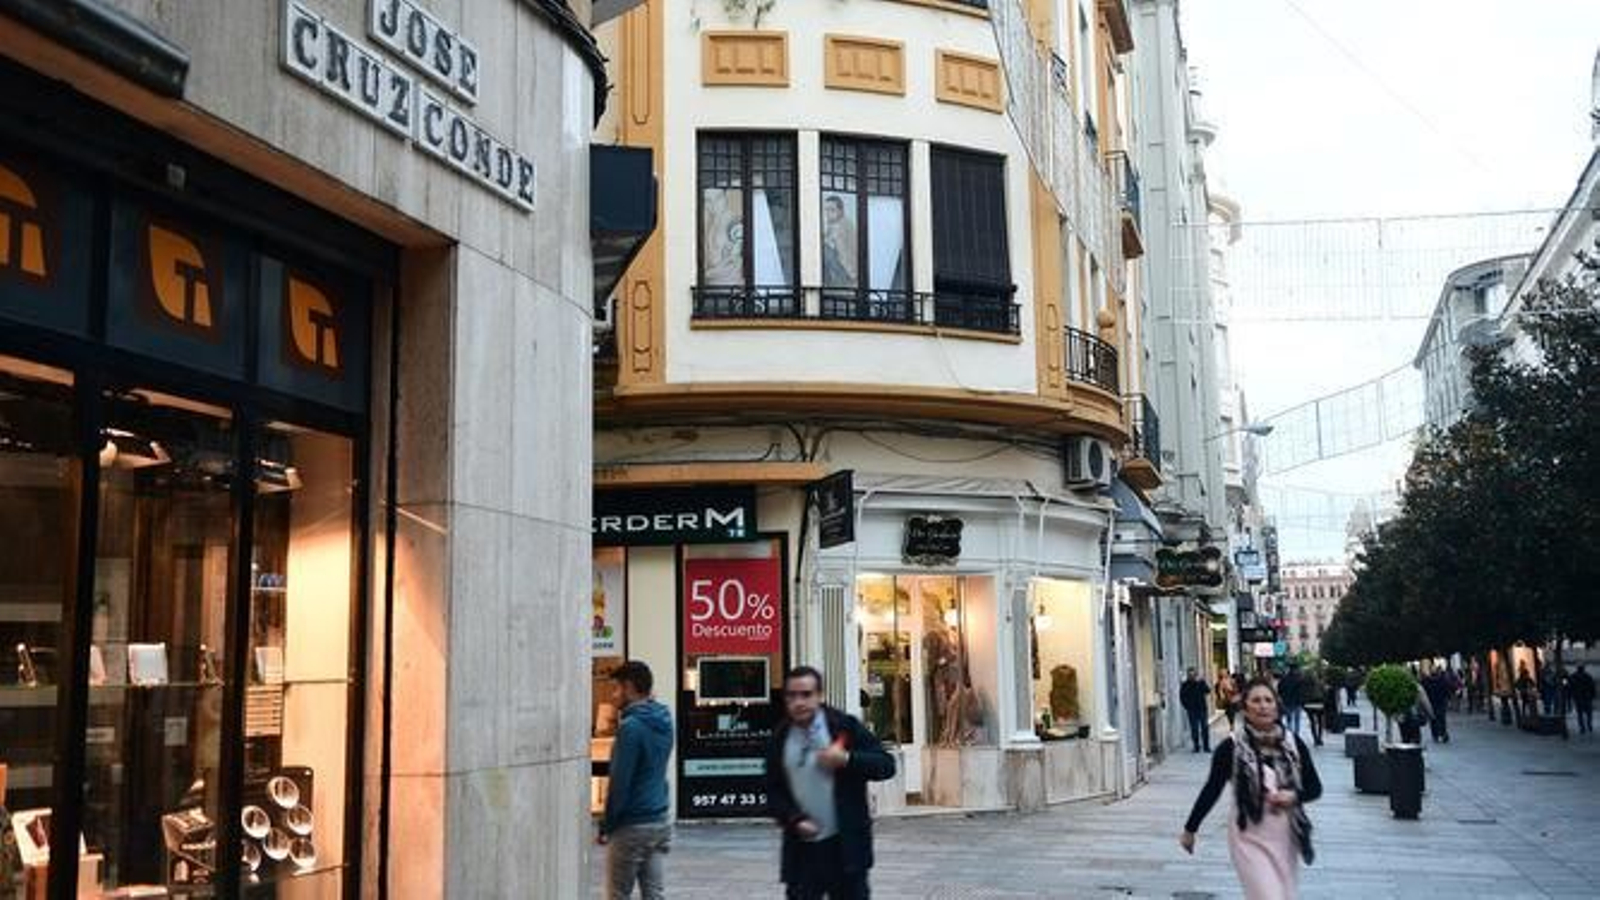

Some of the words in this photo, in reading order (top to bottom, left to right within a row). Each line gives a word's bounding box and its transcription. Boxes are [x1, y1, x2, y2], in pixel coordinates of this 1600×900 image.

[379, 0, 476, 94] JOSE
[293, 17, 410, 126] CRUZ
[423, 102, 533, 204] CONDE
[691, 579, 775, 620] 50%
[692, 623, 772, 638] Descuento
[692, 795, 718, 806] 957
[720, 793, 737, 805] 47
[740, 793, 756, 805] 33
